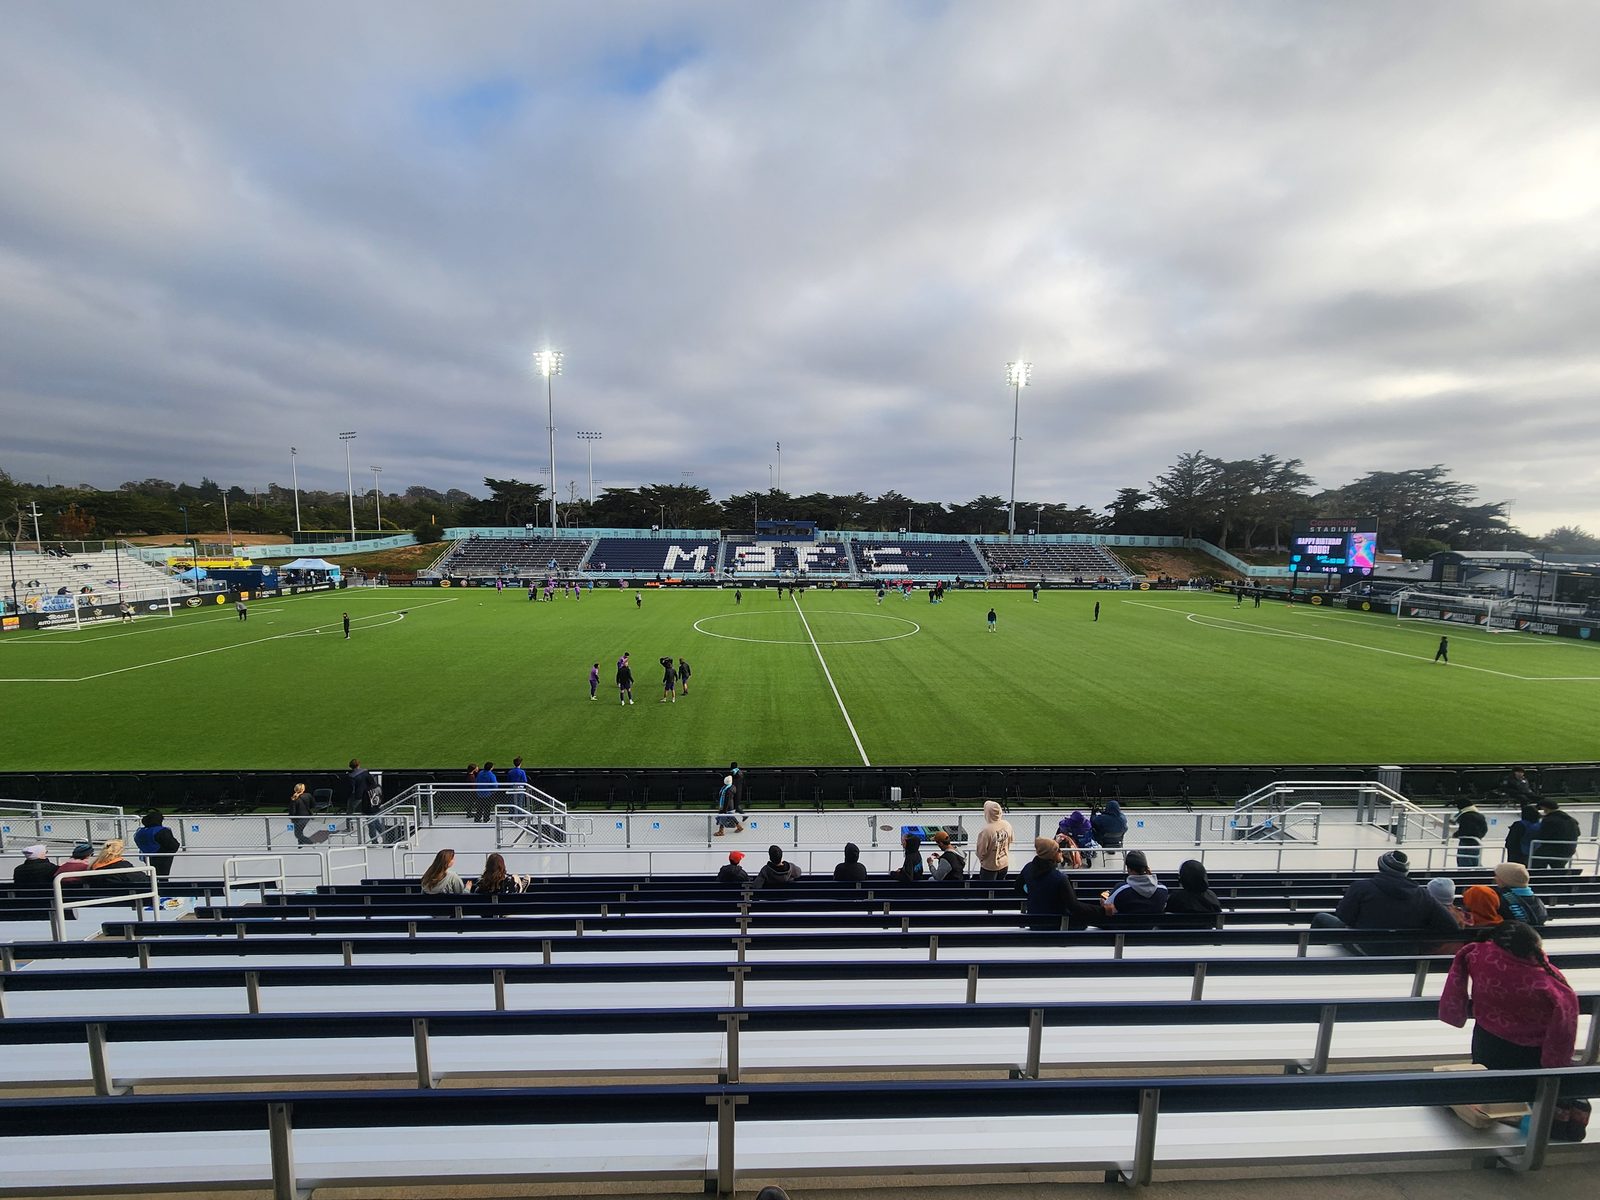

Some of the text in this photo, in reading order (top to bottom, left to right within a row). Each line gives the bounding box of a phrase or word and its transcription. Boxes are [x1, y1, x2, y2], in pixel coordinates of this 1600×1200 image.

[1297, 537, 1343, 546] HAPPY BIRTHDAY
[1308, 545, 1331, 554] DOUG!
